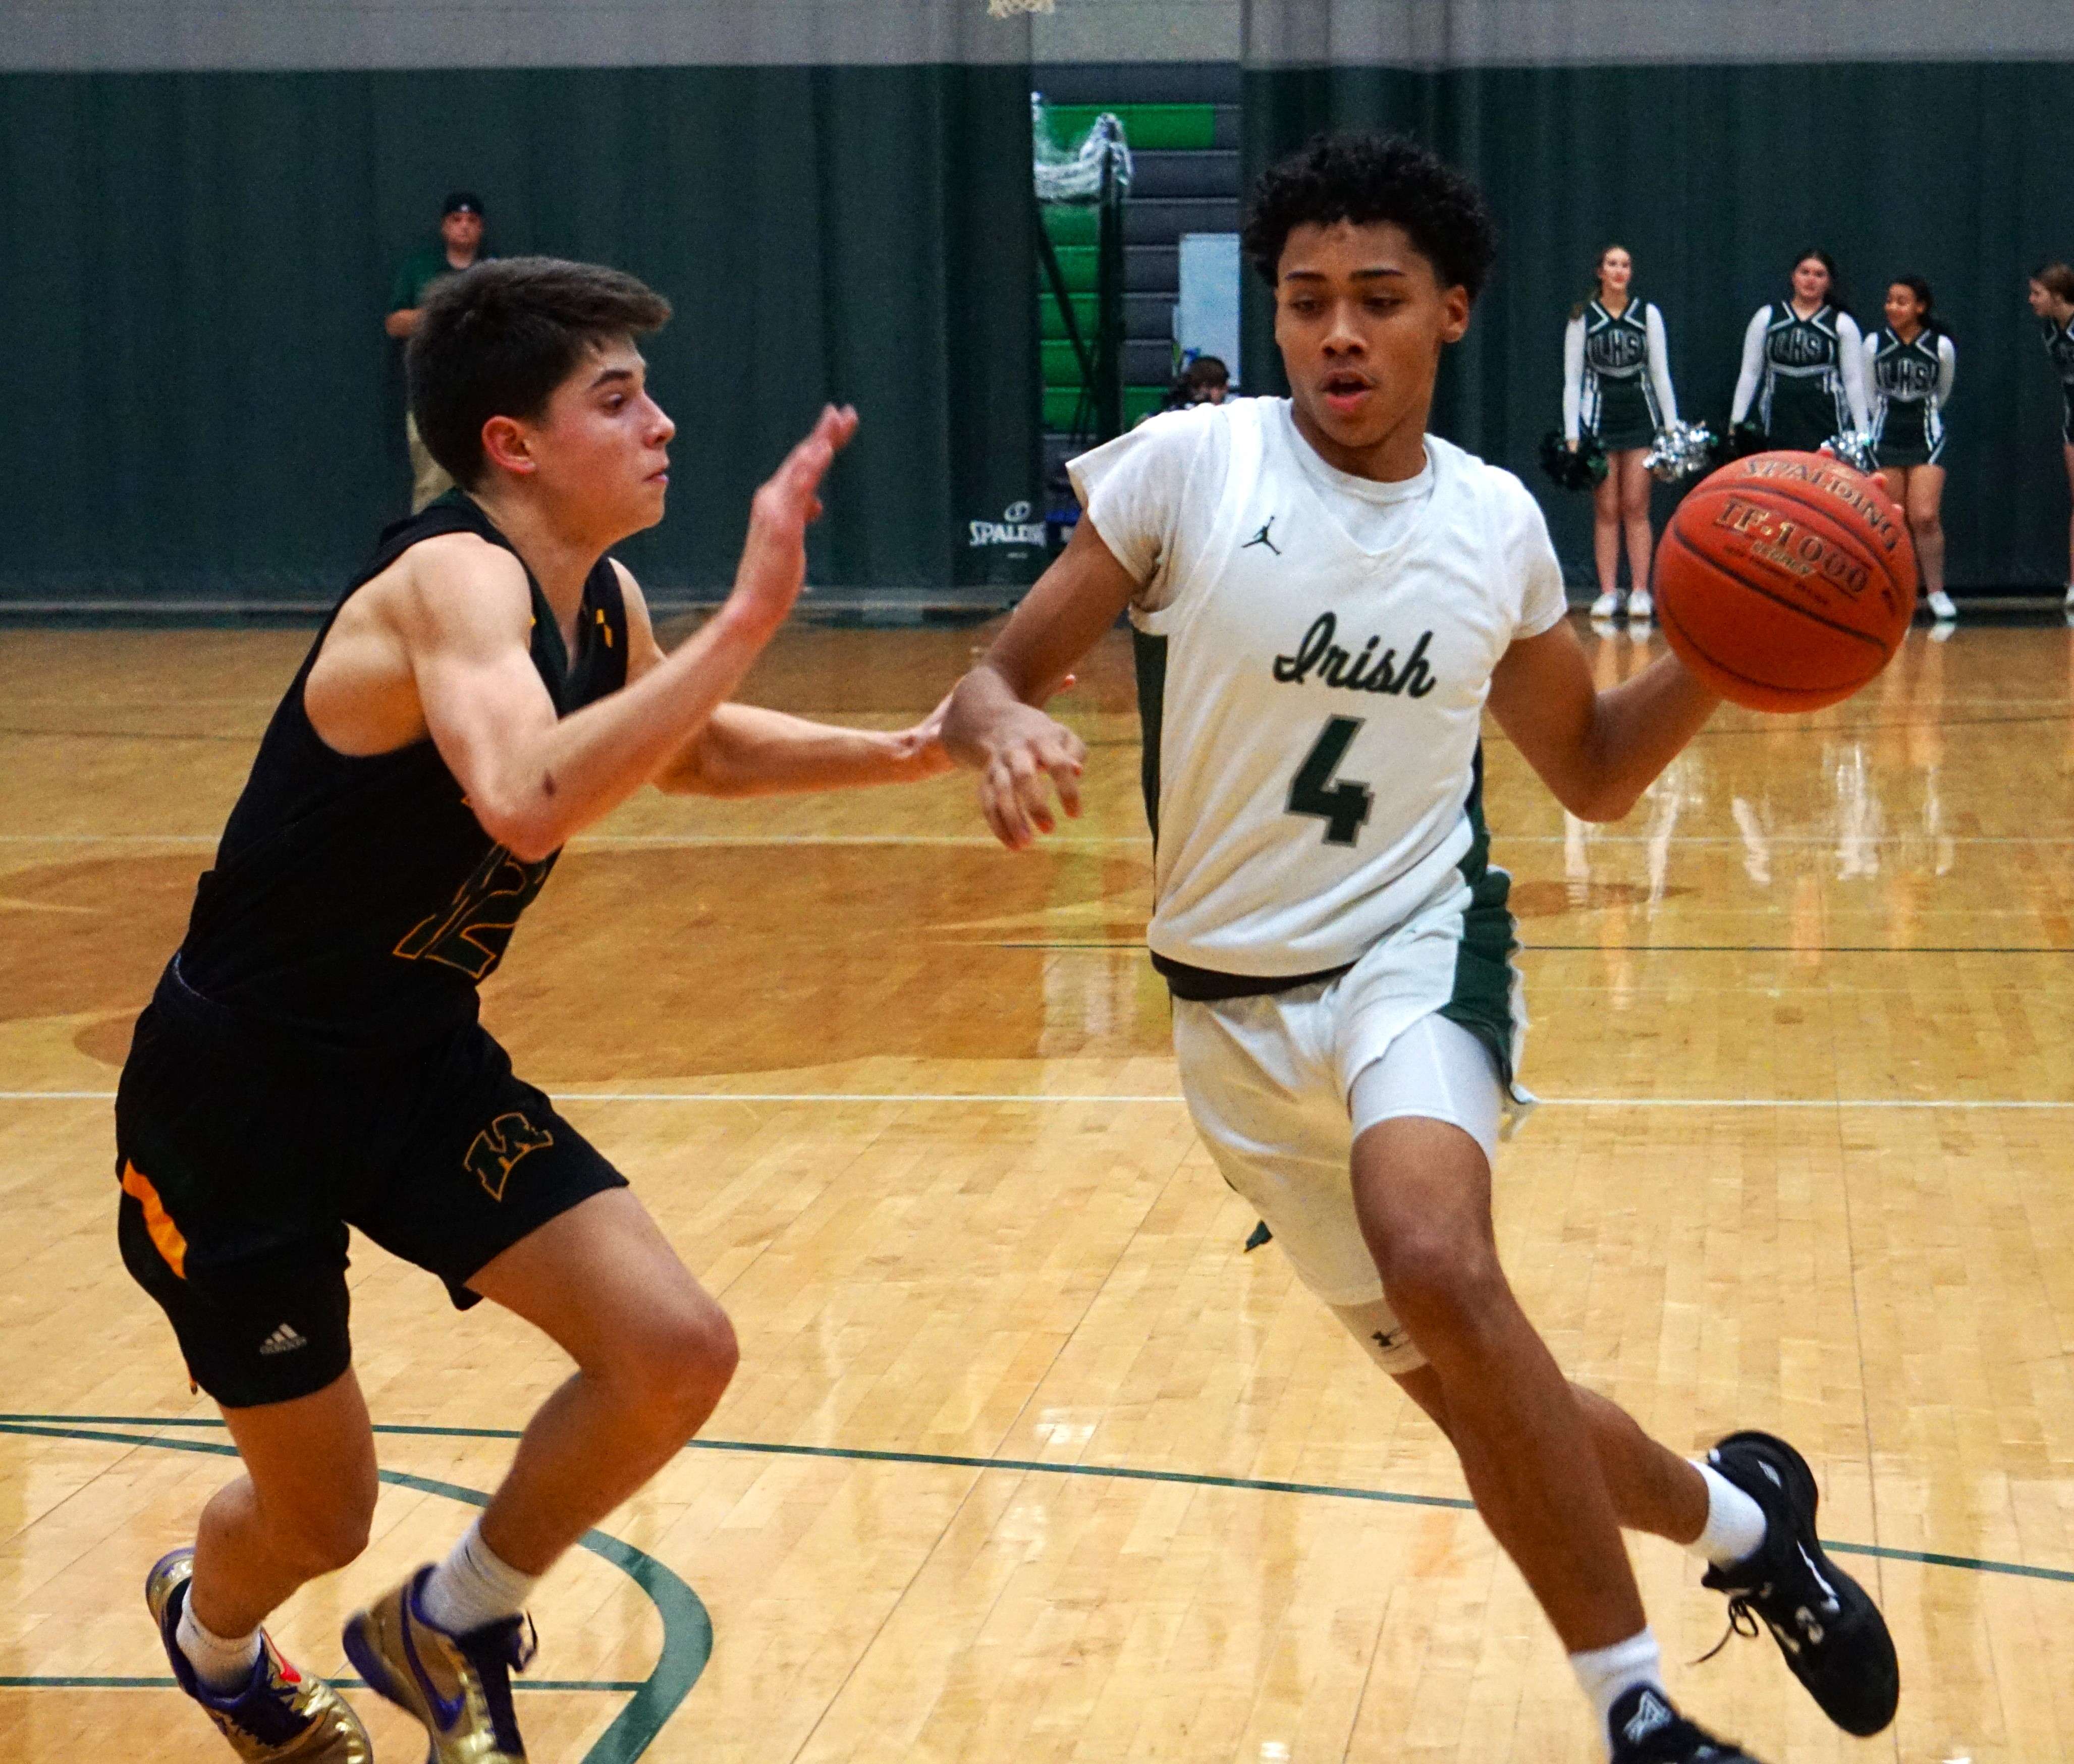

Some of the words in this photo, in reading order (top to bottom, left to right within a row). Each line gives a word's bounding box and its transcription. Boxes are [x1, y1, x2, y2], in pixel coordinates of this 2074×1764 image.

[1715, 499, 1869, 594] TF-1000
[1741, 459, 1898, 551] SPALDING
[1272, 611, 1437, 698] Irish
[1283, 713, 1376, 849] 4
